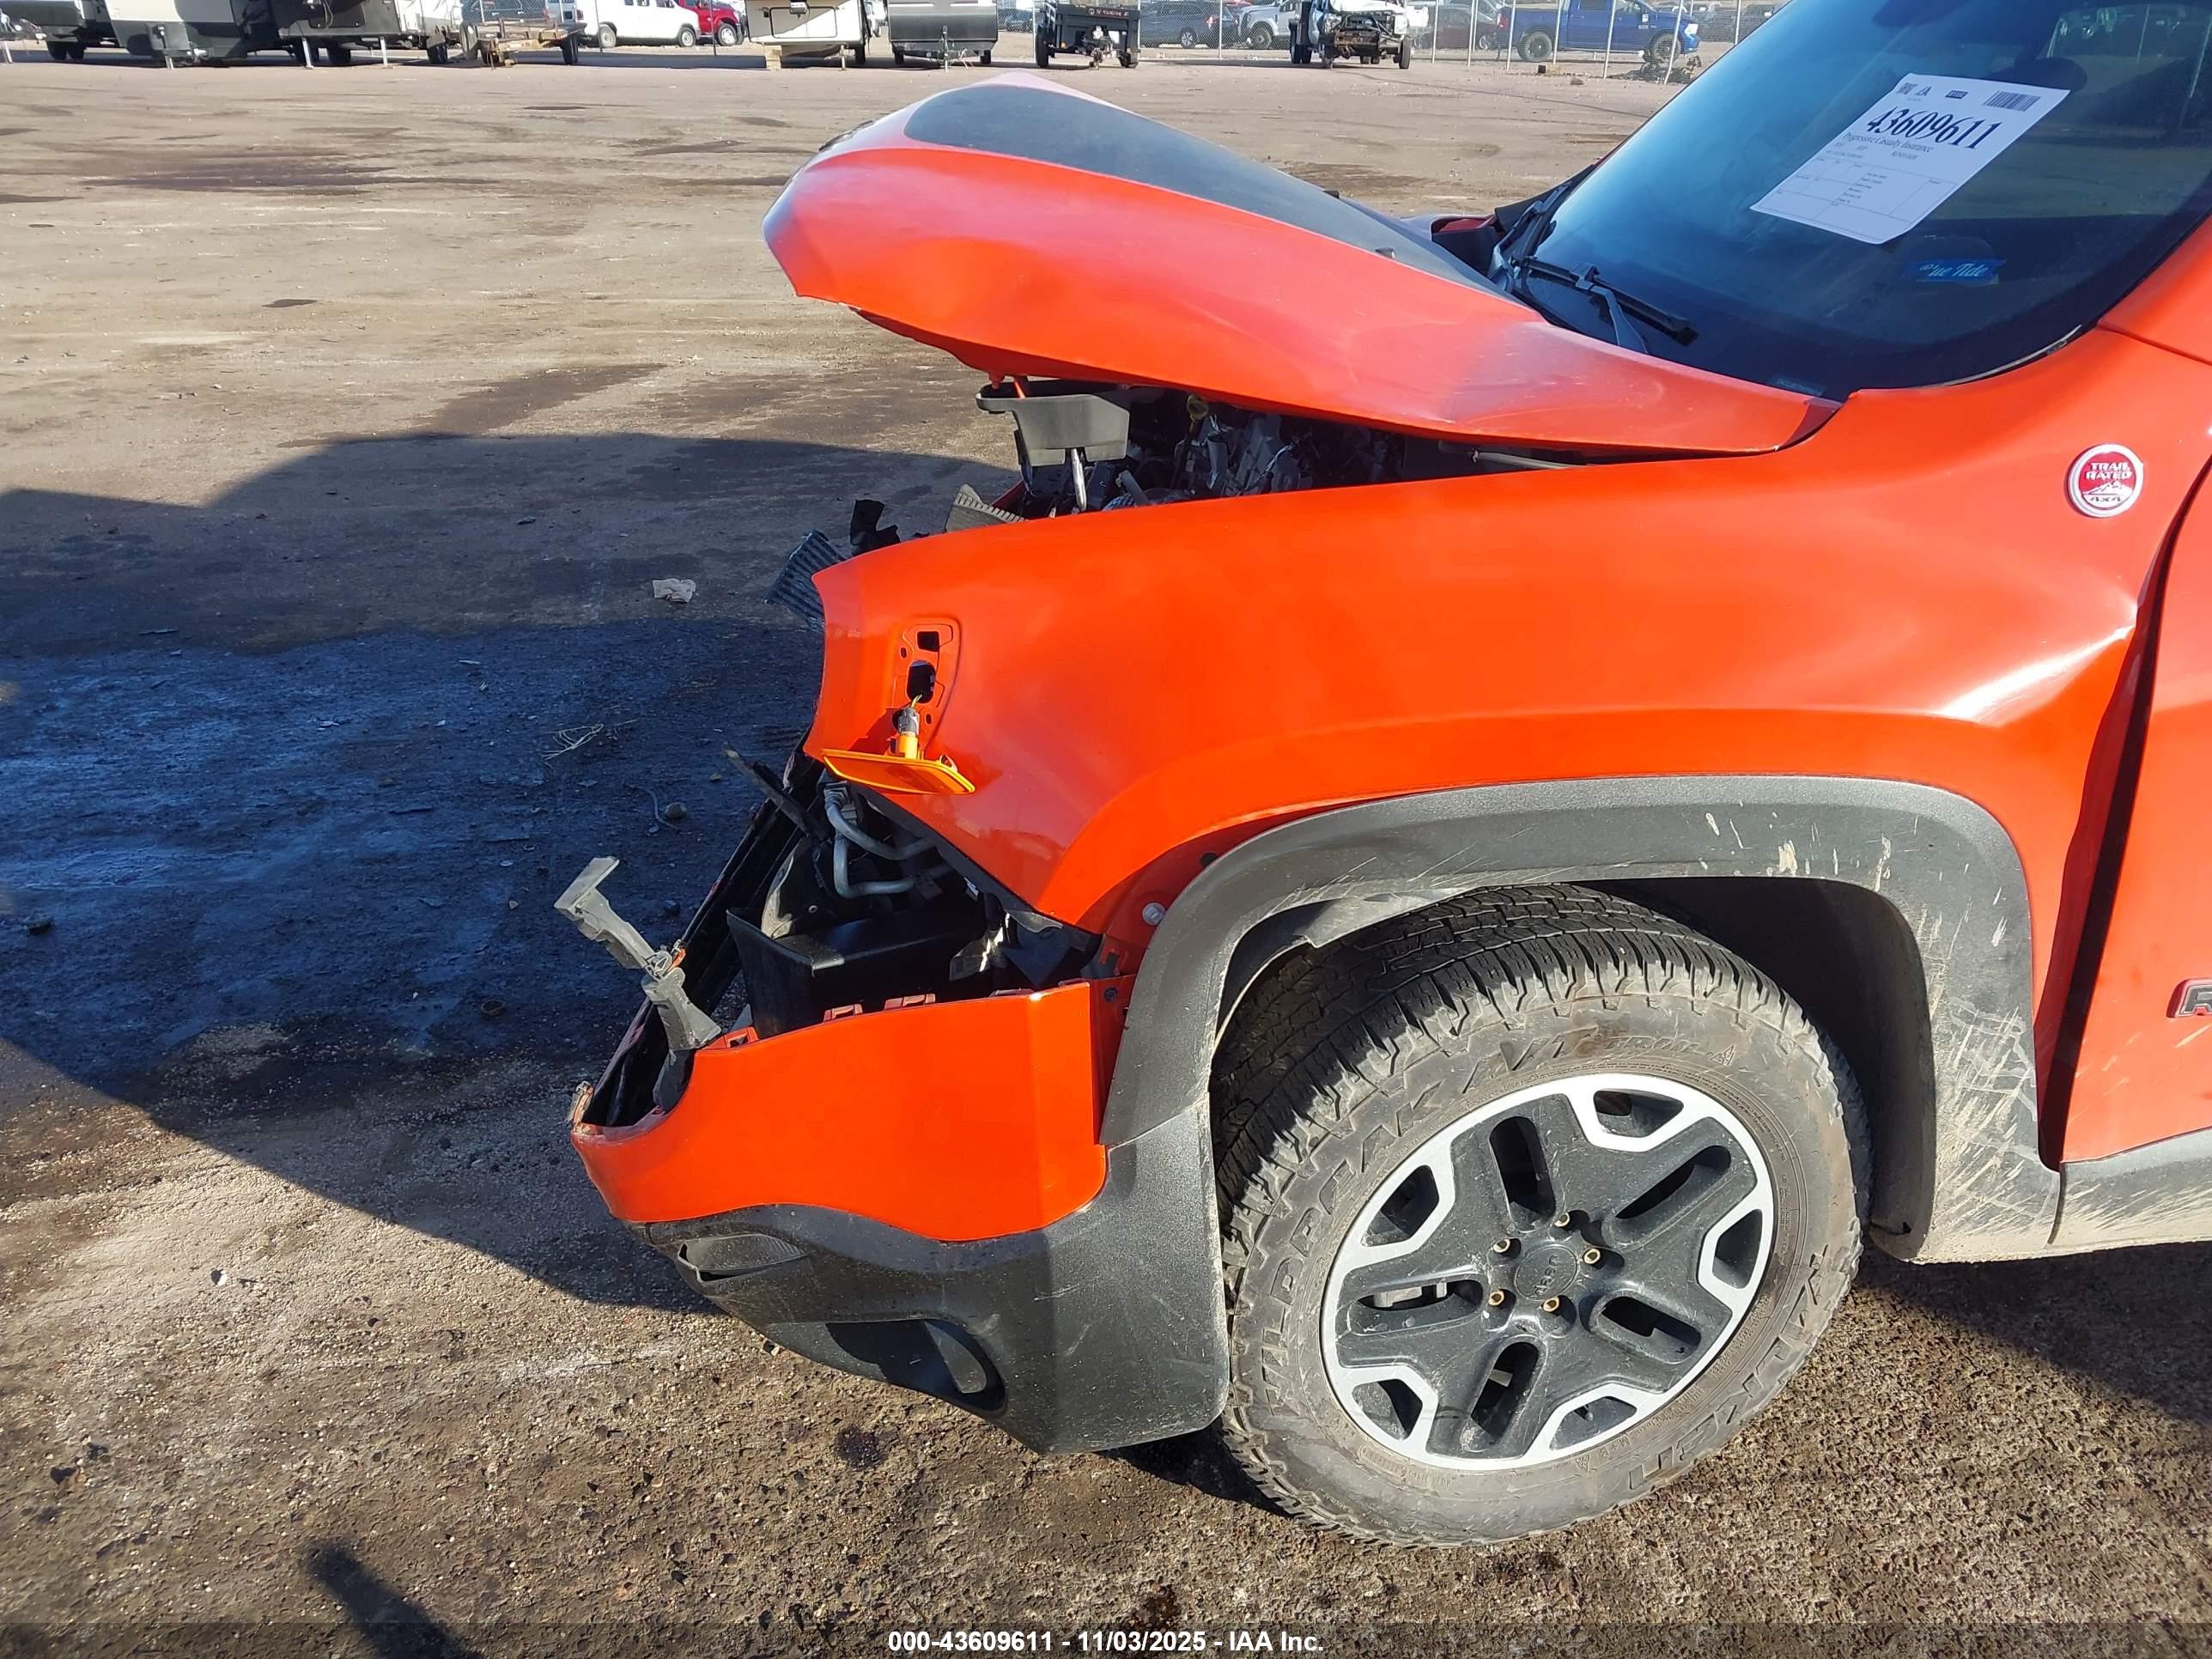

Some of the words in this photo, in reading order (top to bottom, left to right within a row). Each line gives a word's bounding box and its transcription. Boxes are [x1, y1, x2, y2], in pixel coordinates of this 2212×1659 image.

[1867, 106, 2002, 149] 43609611
[2085, 471, 2133, 482] RATED
[2090, 462, 2130, 471] TRAIL
[1534, 1255, 1560, 1295] Jeep
